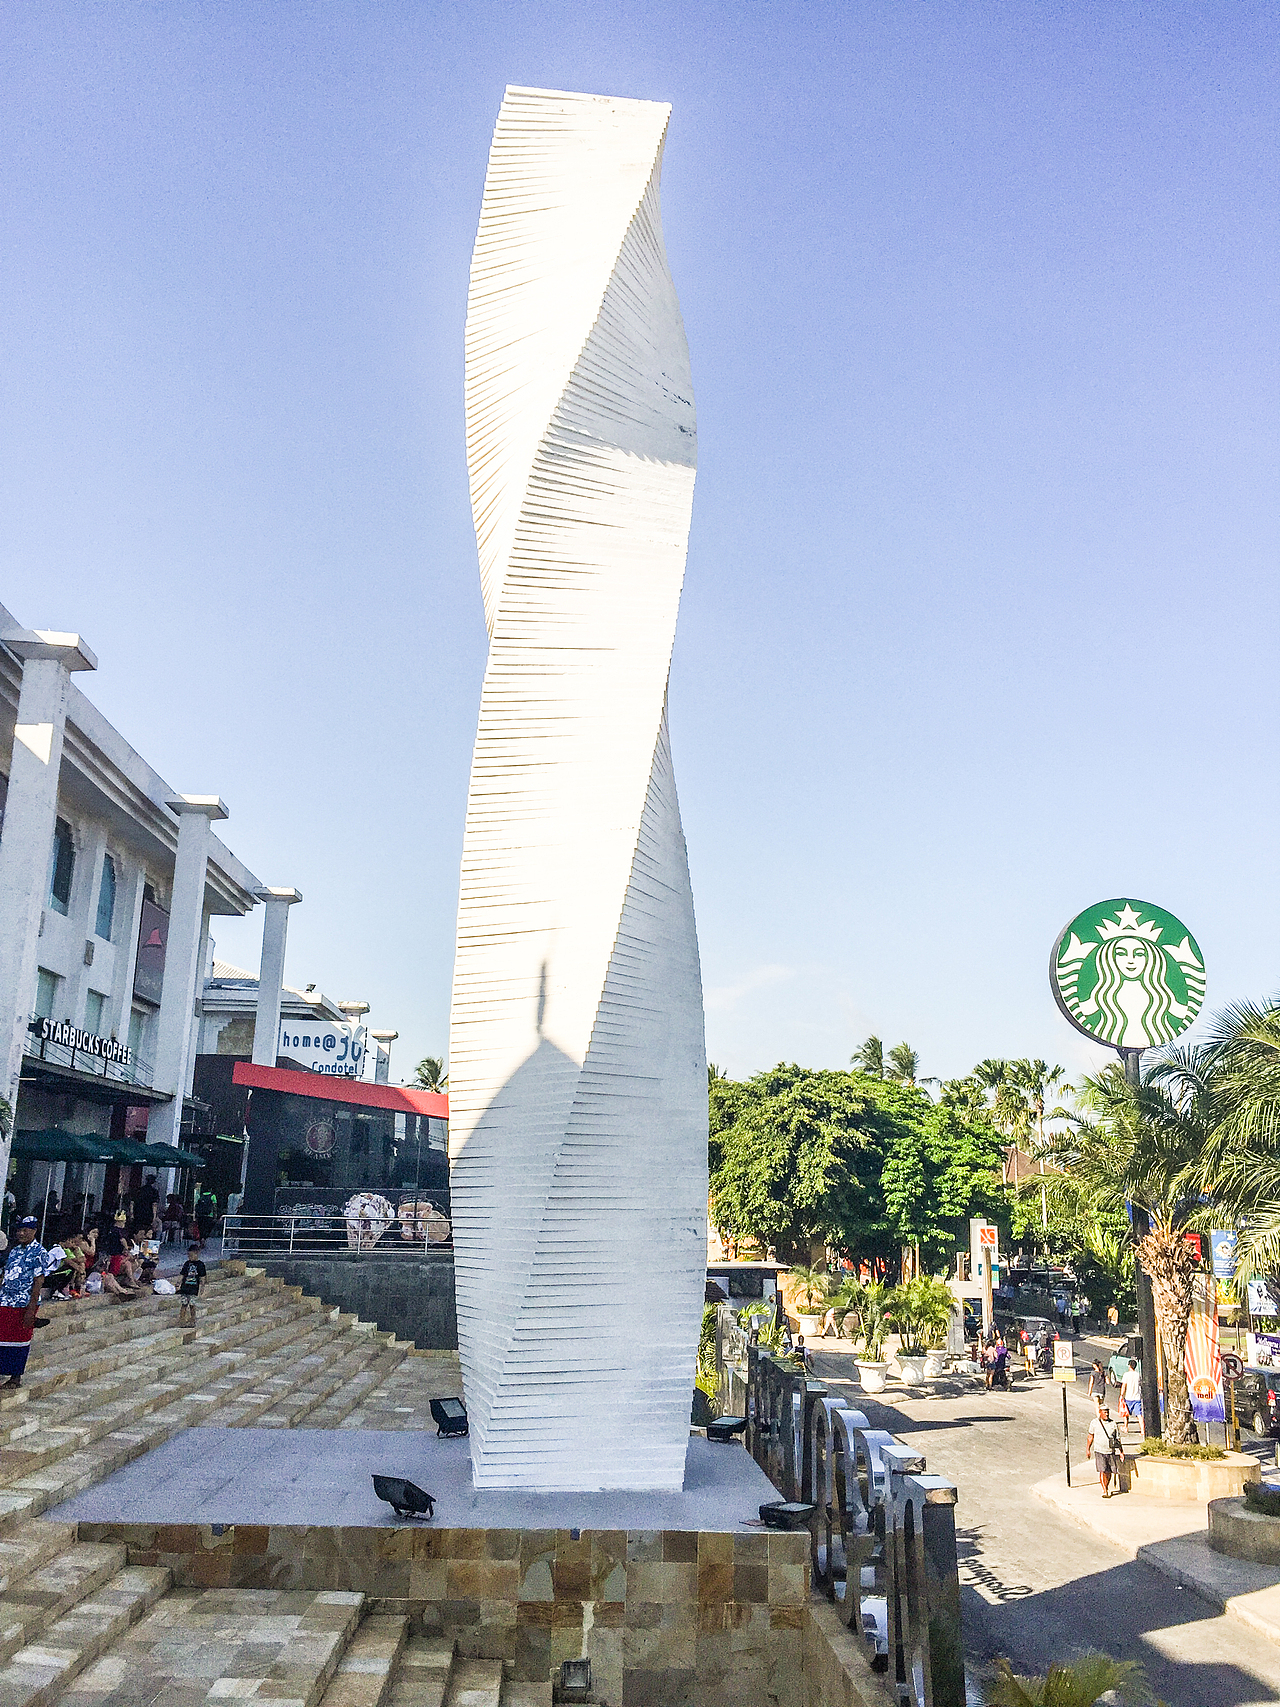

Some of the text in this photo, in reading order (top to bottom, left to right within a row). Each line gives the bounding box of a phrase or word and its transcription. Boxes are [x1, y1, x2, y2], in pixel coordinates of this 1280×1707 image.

[41, 1017, 132, 1065] STARBUCKS COFFEE
[312, 1061, 358, 1075] Condotel
